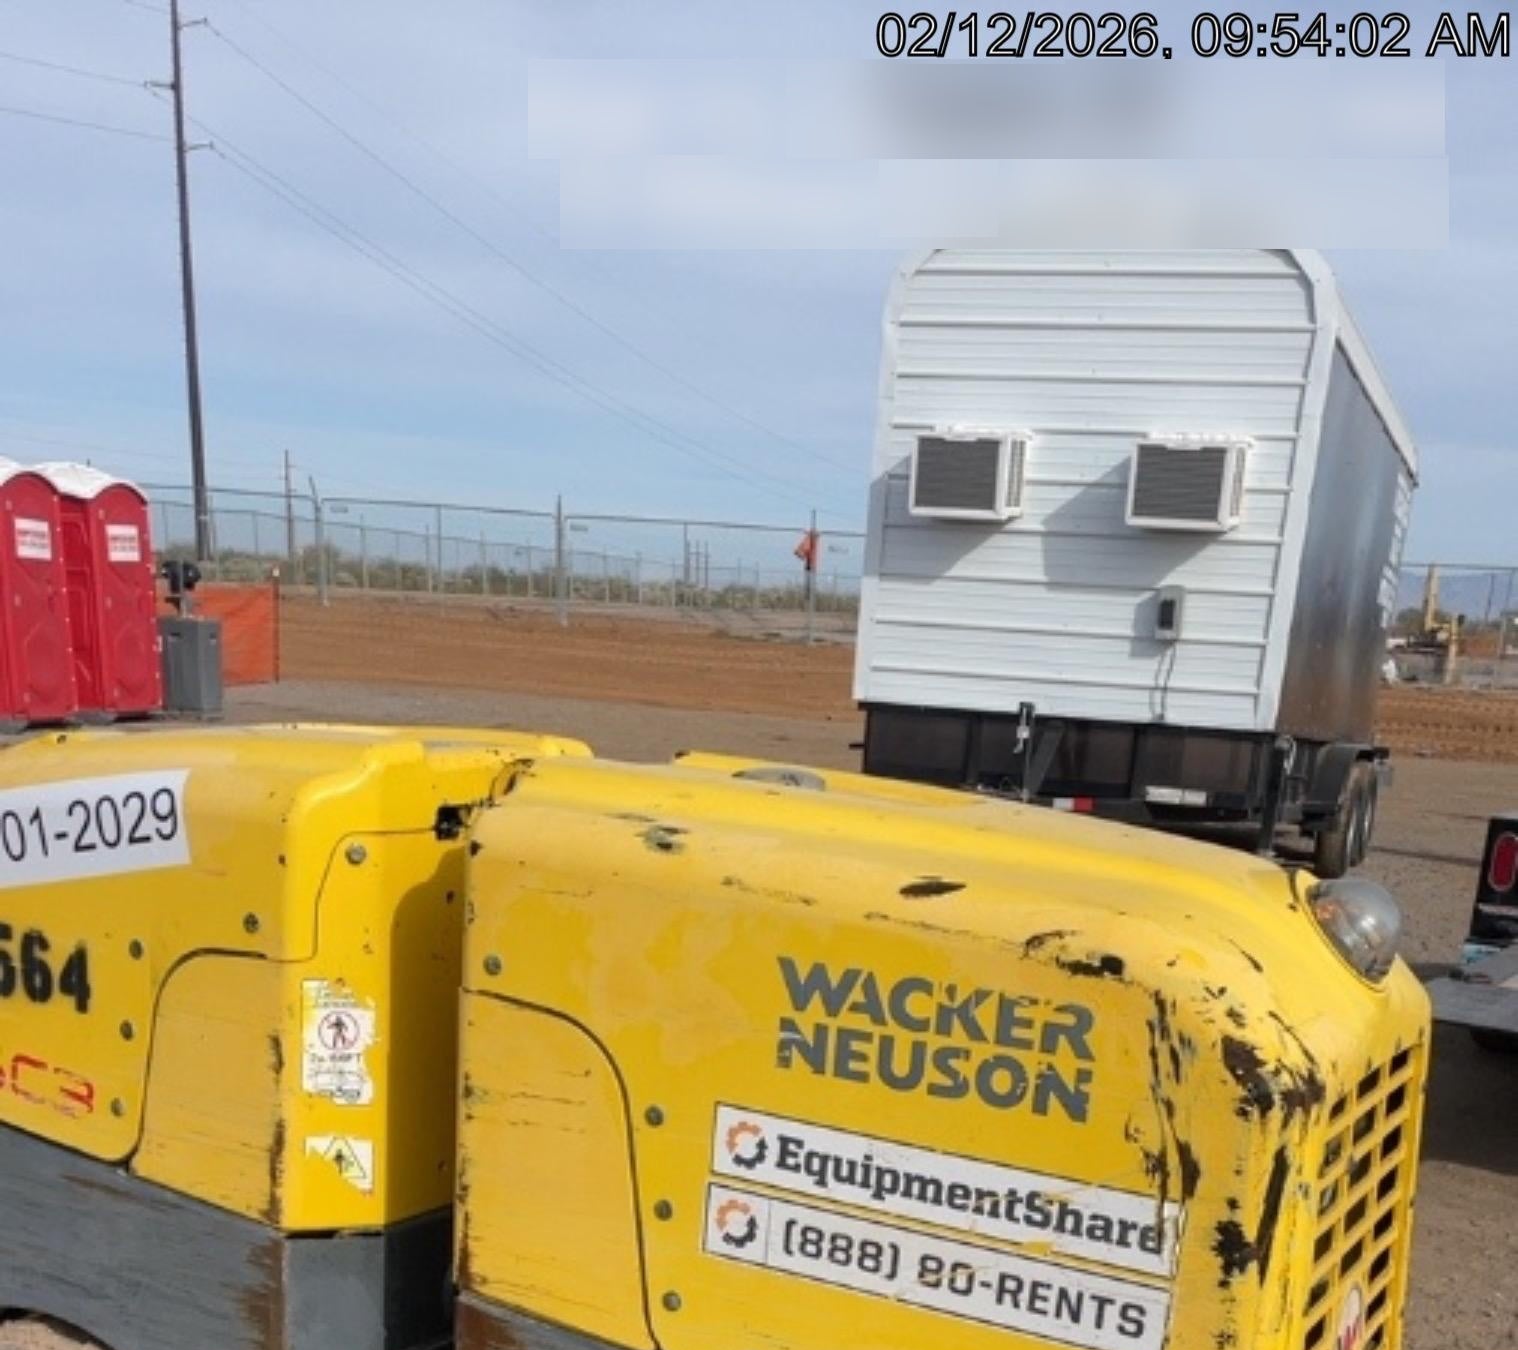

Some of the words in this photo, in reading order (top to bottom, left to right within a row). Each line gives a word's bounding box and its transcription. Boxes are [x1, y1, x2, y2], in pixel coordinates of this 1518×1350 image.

[1, 787, 178, 862] 01-2029
[776, 956, 1096, 1062] WACKER
[776, 1016, 1094, 1123] NEUSON
[774, 1133, 1165, 1255] EquipmentShare
[781, 1219, 899, 1281] (888)
[917, 1253, 1147, 1339] 80-RENTS
